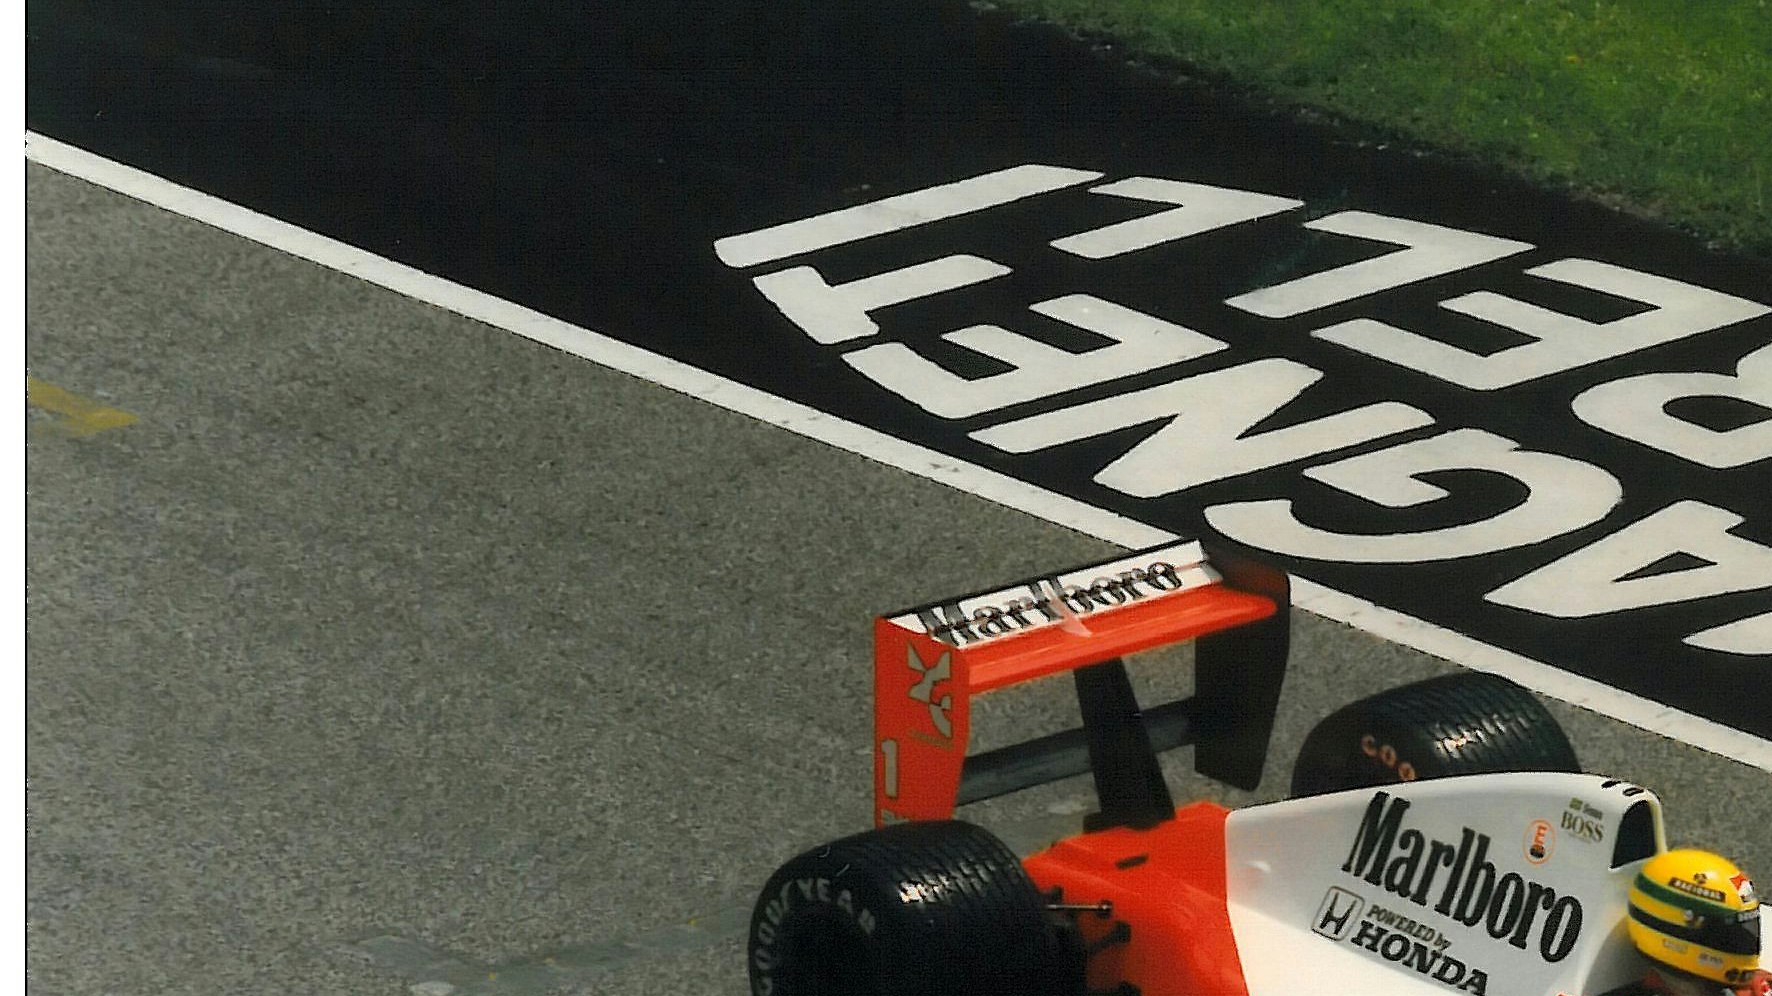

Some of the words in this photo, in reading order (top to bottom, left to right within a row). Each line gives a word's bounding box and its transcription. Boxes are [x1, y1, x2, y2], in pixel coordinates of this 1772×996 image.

[917, 561, 1183, 648] Marlboro
[1560, 810, 1605, 843] BOSS
[1341, 791, 1584, 964] Marlboro
[1366, 904, 1440, 944] POWERED
